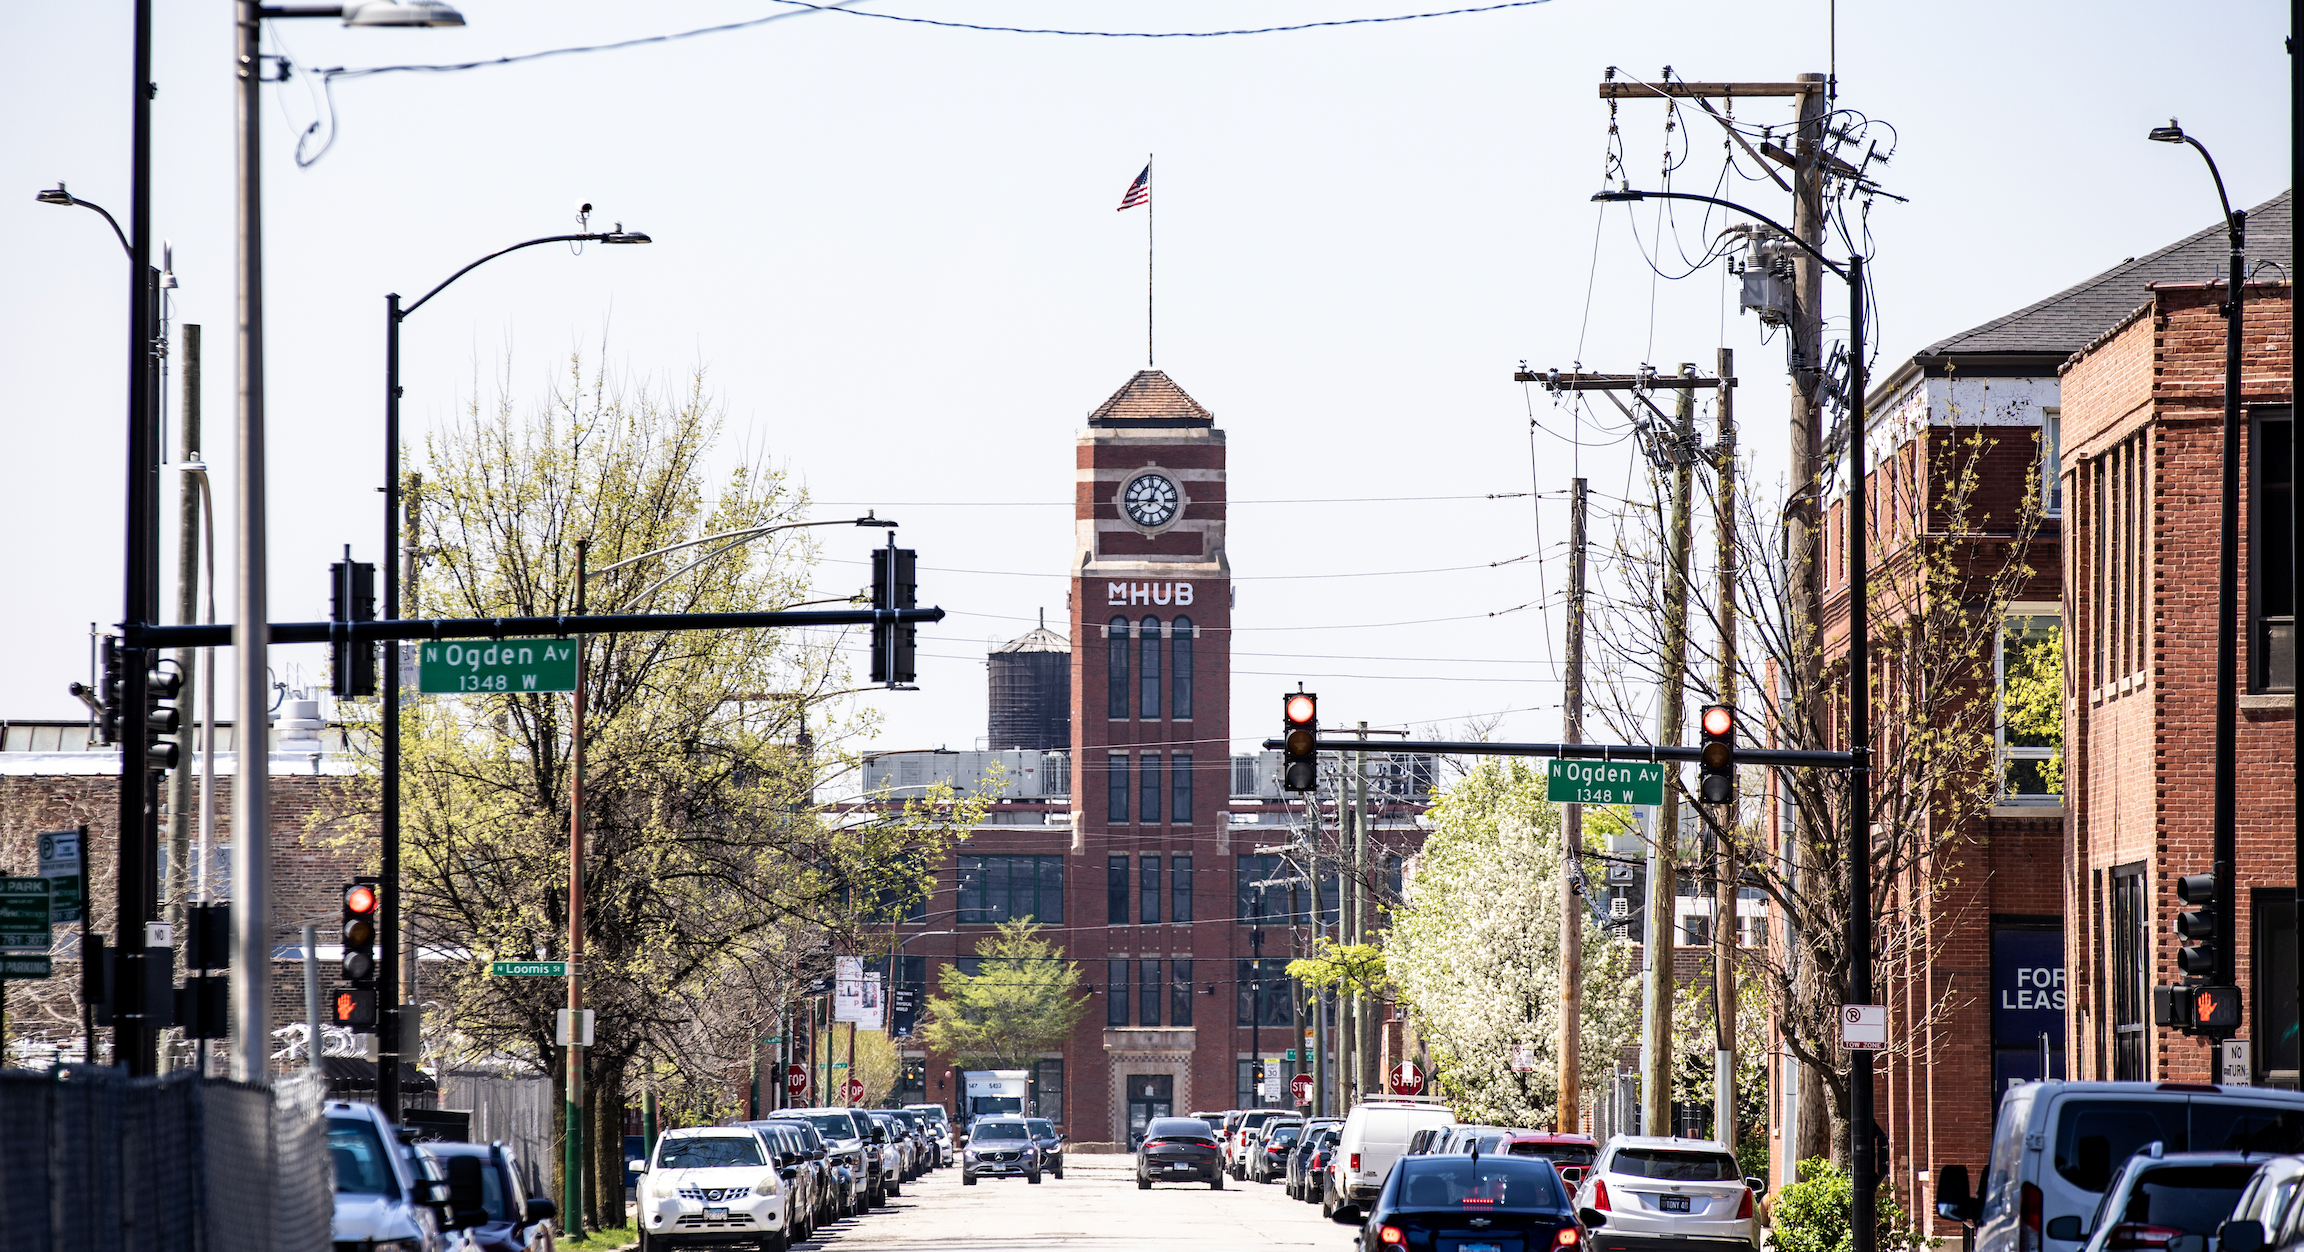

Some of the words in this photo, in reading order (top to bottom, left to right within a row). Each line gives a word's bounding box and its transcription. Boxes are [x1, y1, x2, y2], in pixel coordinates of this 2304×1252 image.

[426, 647, 437, 663] N
[445, 644, 533, 673] Ogden
[543, 645, 570, 661] Av
[459, 674, 508, 691] 1348
[522, 674, 537, 690] W
[1553, 764, 1561, 777] N
[1566, 763, 1631, 787] Ogden
[1638, 768, 1659, 782] Av
[1577, 788, 1612, 803] 1348
[1622, 790, 1634, 803] W
[7, 881, 43, 892] PARK
[3, 935, 21, 945] 761
[25, 935, 44, 945] 307
[154, 929, 164, 941] NO
[6, 961, 47, 974] PARKING
[506, 963, 550, 974] Loomis
[2002, 989, 2066, 1011] LEAS
[2231, 1045, 2242, 1059] NO
[2228, 1064, 2246, 1077] TURN
[788, 1074, 806, 1087] TOP
[841, 1086, 864, 1096] SOP
